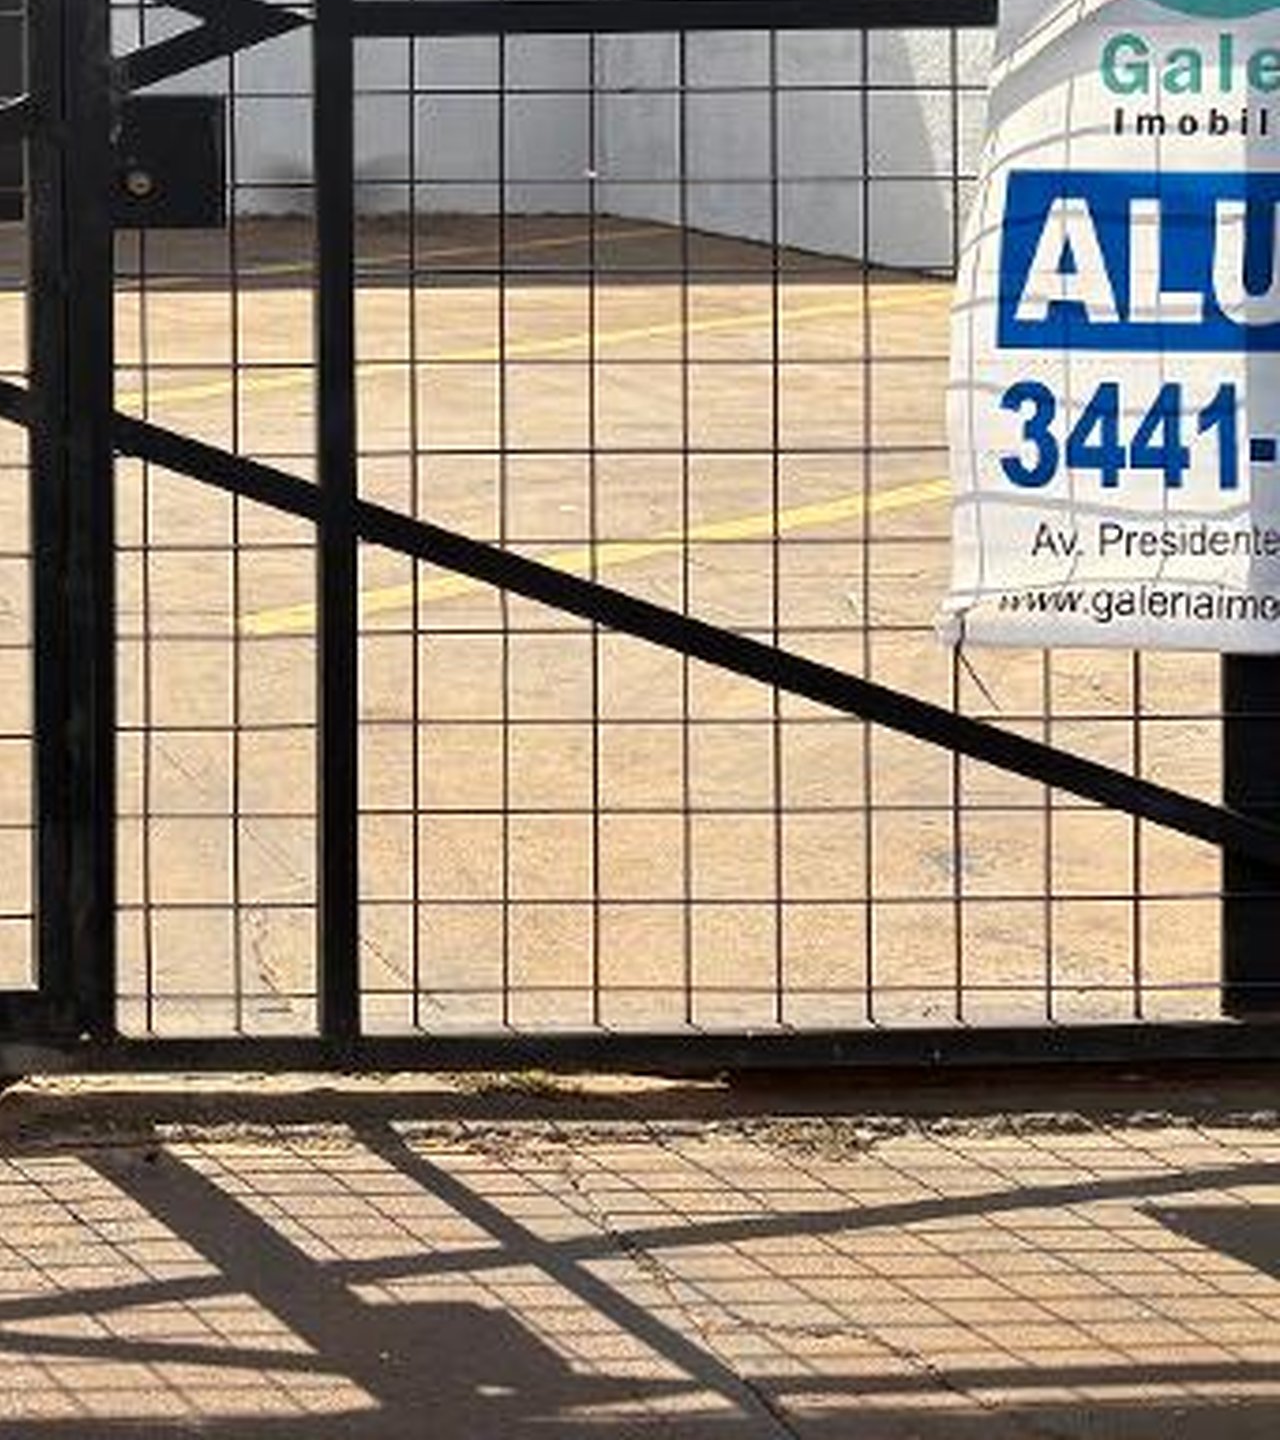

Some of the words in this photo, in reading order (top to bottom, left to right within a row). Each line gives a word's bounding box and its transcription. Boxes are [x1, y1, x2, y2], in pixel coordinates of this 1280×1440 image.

[1100, 32, 1280, 95] Gale
[1114, 107, 1268, 137] Imobil
[1013, 197, 1280, 327] ALU
[997, 380, 1277, 490] 3441-
[1031, 521, 1084, 557] Av.
[1098, 522, 1280, 558] Presidente
